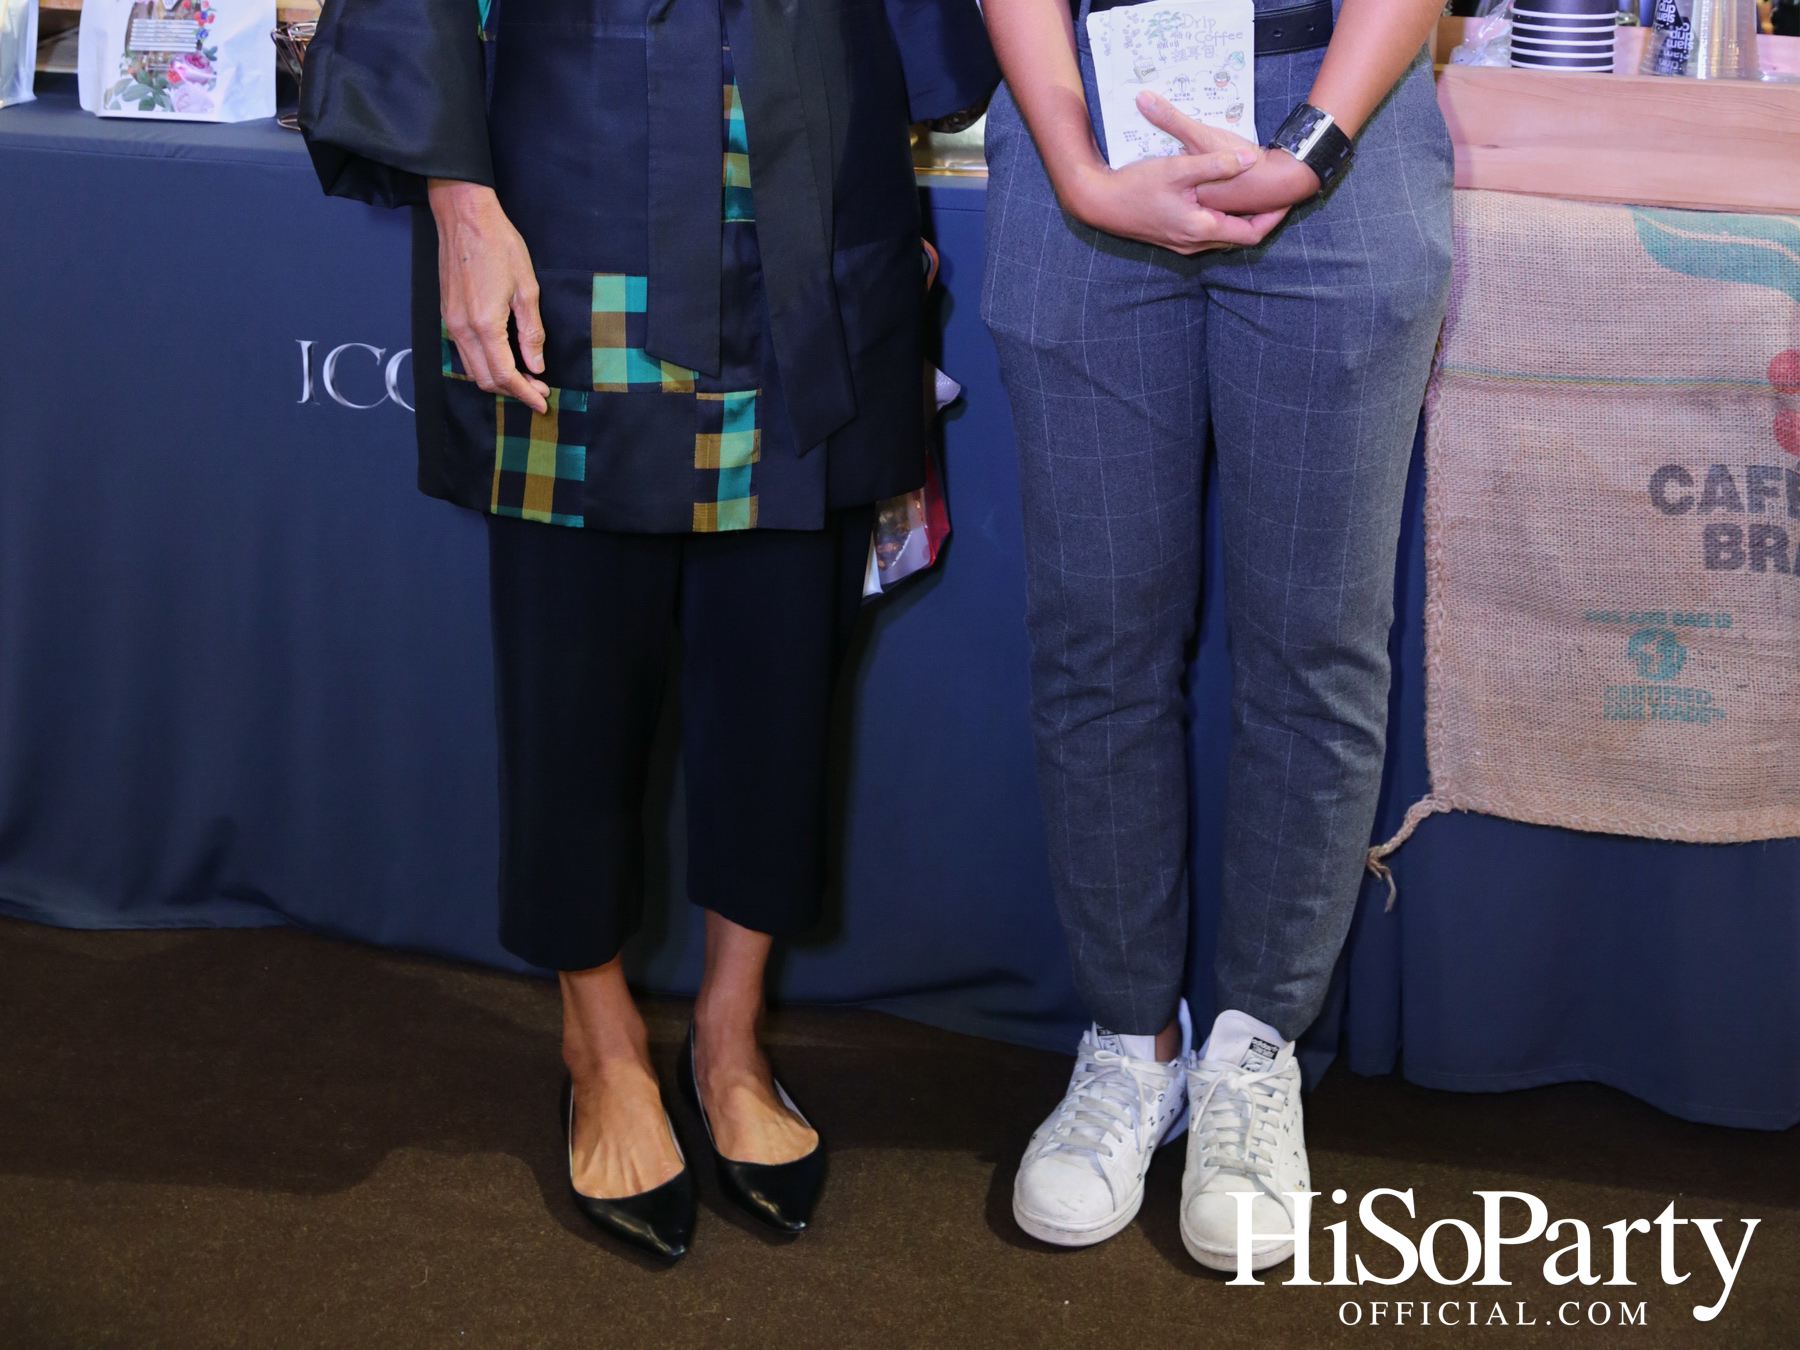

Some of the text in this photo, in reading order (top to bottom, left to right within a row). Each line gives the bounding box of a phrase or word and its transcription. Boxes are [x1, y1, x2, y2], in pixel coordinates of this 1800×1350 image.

[1182, 13, 1217, 34] Drip
[1194, 30, 1244, 47] Coffee
[1703, 522, 1800, 577] BR
[1604, 685, 1712, 705] CERTIFIED
[1603, 703, 1645, 721] FAIR
